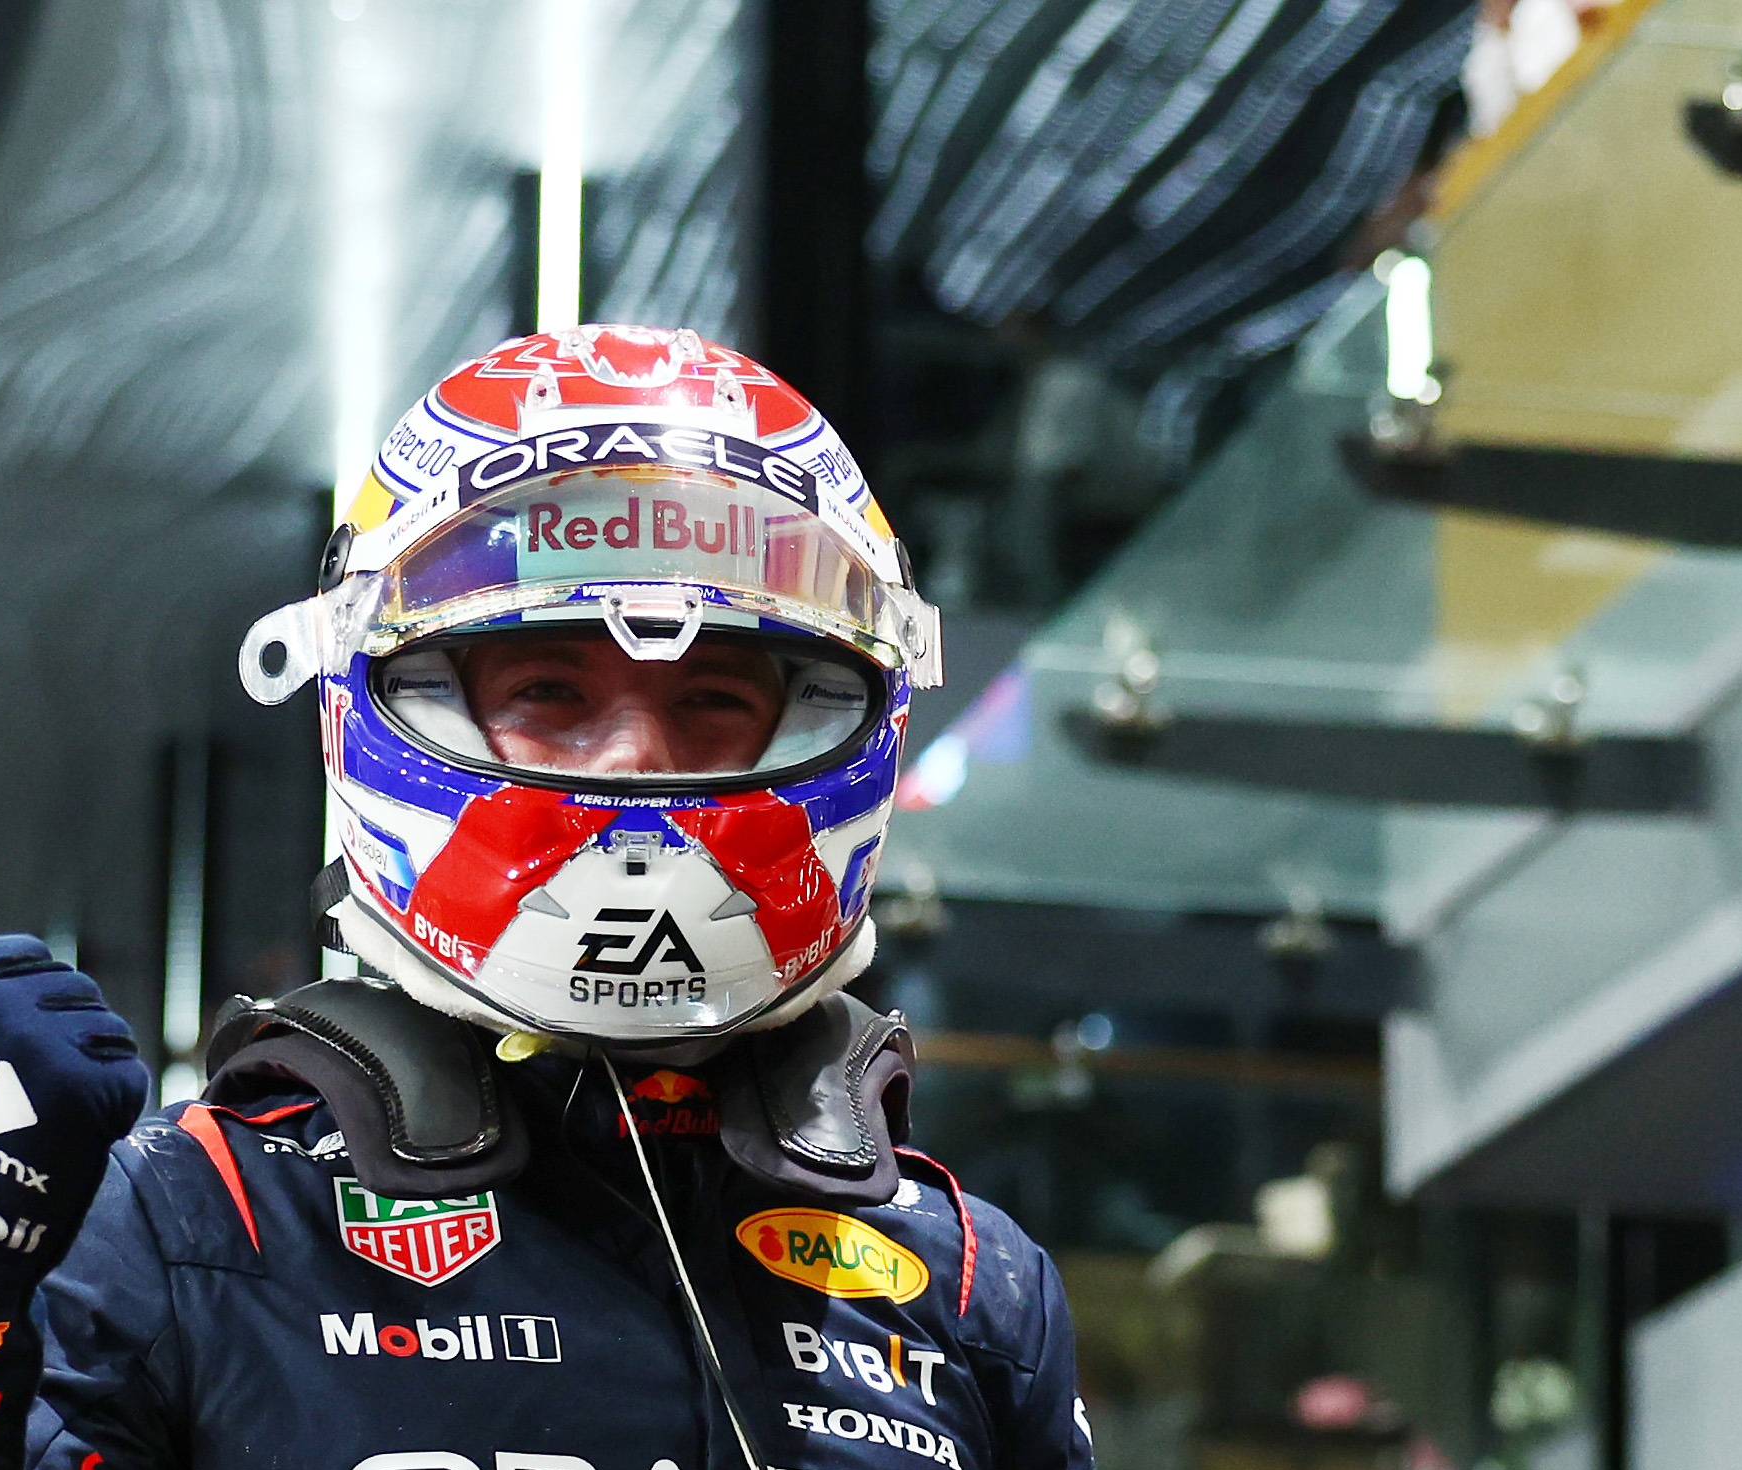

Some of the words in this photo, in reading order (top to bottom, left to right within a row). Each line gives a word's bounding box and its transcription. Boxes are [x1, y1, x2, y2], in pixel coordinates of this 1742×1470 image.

[469, 425, 807, 502] ORACLE
[527, 497, 640, 553] Red
[652, 500, 756, 557] Bull
[573, 793, 706, 808] VERSTAPPEN.COM
[414, 912, 476, 968] BYBIT
[572, 908, 706, 976] EA
[784, 926, 836, 979] BYBIT
[569, 976, 707, 1008] SPORTS
[350, 1215, 489, 1279] HEUER
[787, 1228, 900, 1291] RAUCH
[319, 1312, 495, 1361] Mobil
[781, 1321, 946, 1407] BYBIT
